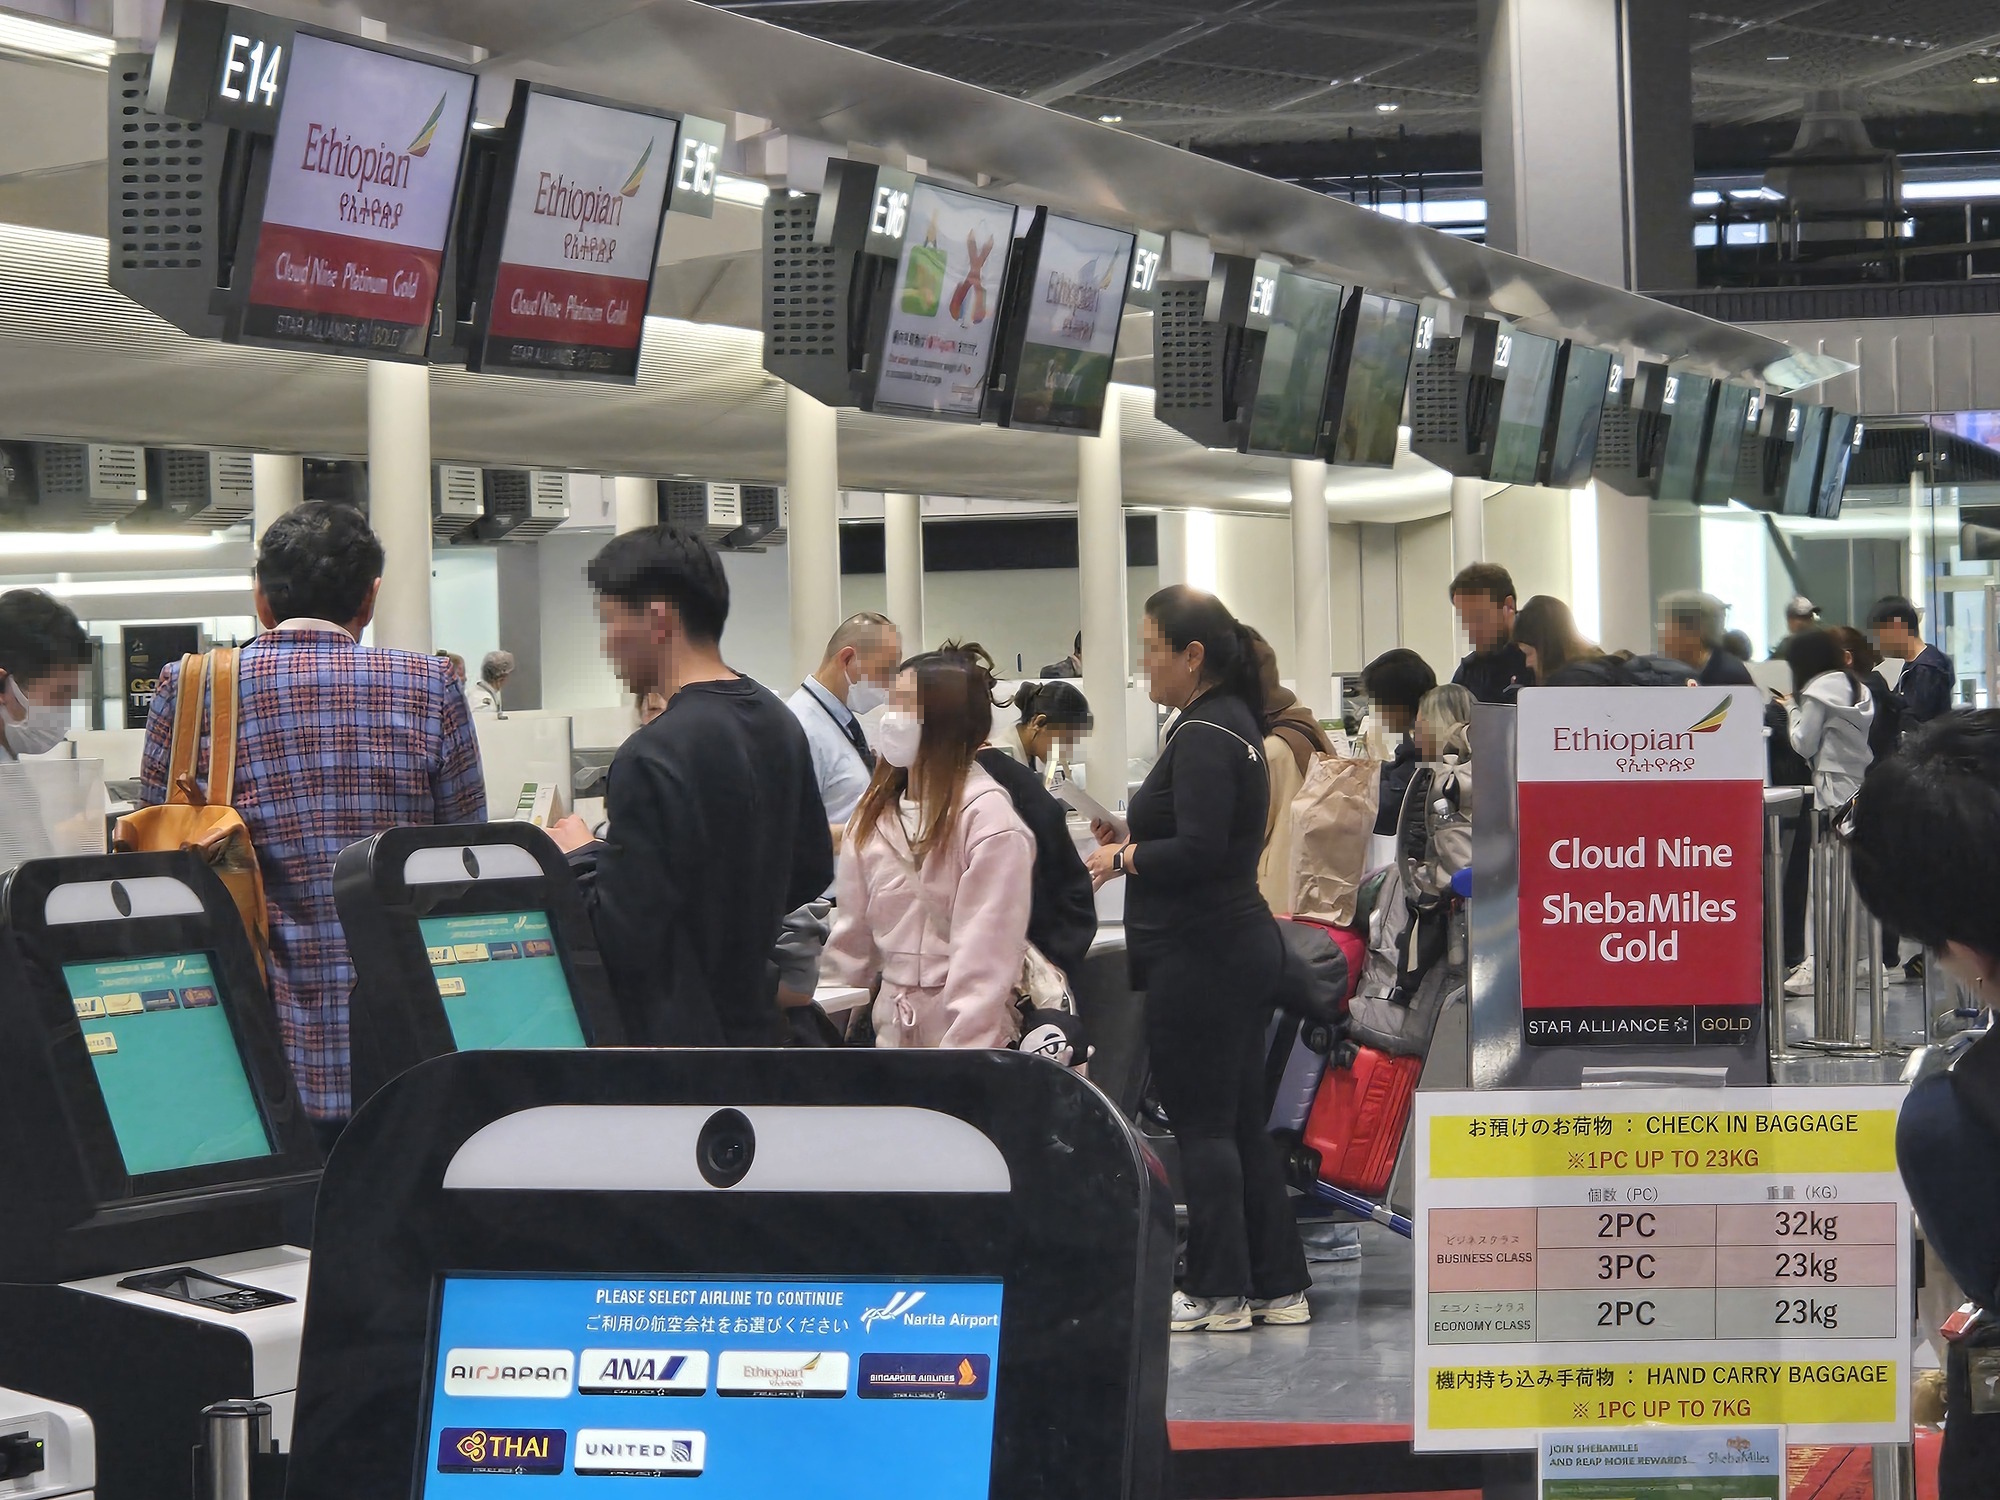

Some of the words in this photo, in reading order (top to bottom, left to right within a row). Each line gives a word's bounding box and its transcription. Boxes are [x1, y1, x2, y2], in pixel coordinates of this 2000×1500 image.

[220, 33, 283, 107] E14
[301, 122, 411, 193] Ethiopian
[676, 138, 719, 196] E15
[533, 171, 623, 232] Ethiopian
[871, 187, 909, 239] E16
[275, 252, 311, 284] Cloud
[311, 257, 338, 288] Nine
[342, 262, 389, 295] Platinum
[393, 270, 420, 299] Gold
[1131, 248, 1160, 292] E17
[511, 288, 540, 316] Cloud
[1554, 726, 1695, 757] Ethiopian
[1549, 836, 1645, 869] Cloud
[1658, 836, 1733, 868] Nine
[1542, 891, 1737, 925] ShebaMiles
[1600, 930, 1678, 962] Gold
[1529, 1020, 1572, 1035] STAR
[1578, 1018, 1670, 1033] ALLIANCE
[1701, 1017, 1752, 1032] GOLD
[1468, 1116, 1613, 1138] お預けのお荷物
[1646, 1115, 1719, 1134] CHECK
[1727, 1115, 1748, 1133] IN
[1755, 1113, 1858, 1133] BAGGAGE
[1635, 1150, 1664, 1169] UP
[1671, 1149, 1699, 1168] TO
[1706, 1149, 1759, 1168] 23KG
[1598, 1212, 1656, 1239] 2PC
[1775, 1210, 1839, 1241] 32kg
[1436, 1252, 1493, 1264] BUSINESS
[1496, 1252, 1532, 1263] CLASS
[1598, 1254, 1656, 1280] 3PC
[1775, 1252, 1838, 1283] 23kg
[596, 1289, 646, 1304] PLEASE
[649, 1290, 697, 1305] SELECT
[700, 1290, 751, 1306] AIRLINE
[756, 1291, 772, 1306] TO
[777, 1291, 844, 1307] CONTINUE
[586, 1314, 850, 1335] ご利用の航空会社をお選びください
[904, 1313, 946, 1326] Narita
[949, 1312, 999, 1328] Airport
[1434, 1320, 1493, 1332] ECONOMY
[1495, 1320, 1531, 1331] CLASS
[1597, 1300, 1656, 1327] 2PC
[1775, 1299, 1838, 1329] 23kg
[599, 1358, 657, 1381] ANA
[743, 1365, 804, 1380] Ethiopian
[870, 1374, 916, 1382] SINGAPORE
[918, 1374, 955, 1382] AIRLINES
[1436, 1368, 1614, 1390] 機内持ち込み手荷物
[1647, 1367, 1706, 1385] HAND
[1712, 1366, 1781, 1384] CARRY
[1789, 1365, 1888, 1383] BAGGAGE
[1597, 1400, 1636, 1418] 1PC
[1643, 1400, 1671, 1418] UP
[1678, 1399, 1705, 1417] TO
[1712, 1399, 1751, 1417] 7KG
[489, 1436, 549, 1458] THAI
[586, 1443, 666, 1457] UNITED
[1549, 1444, 1574, 1457] JOIN
[1549, 1457, 1573, 1466] AND
[1576, 1457, 1602, 1466] REAP
[1605, 1456, 1634, 1466] MORE
